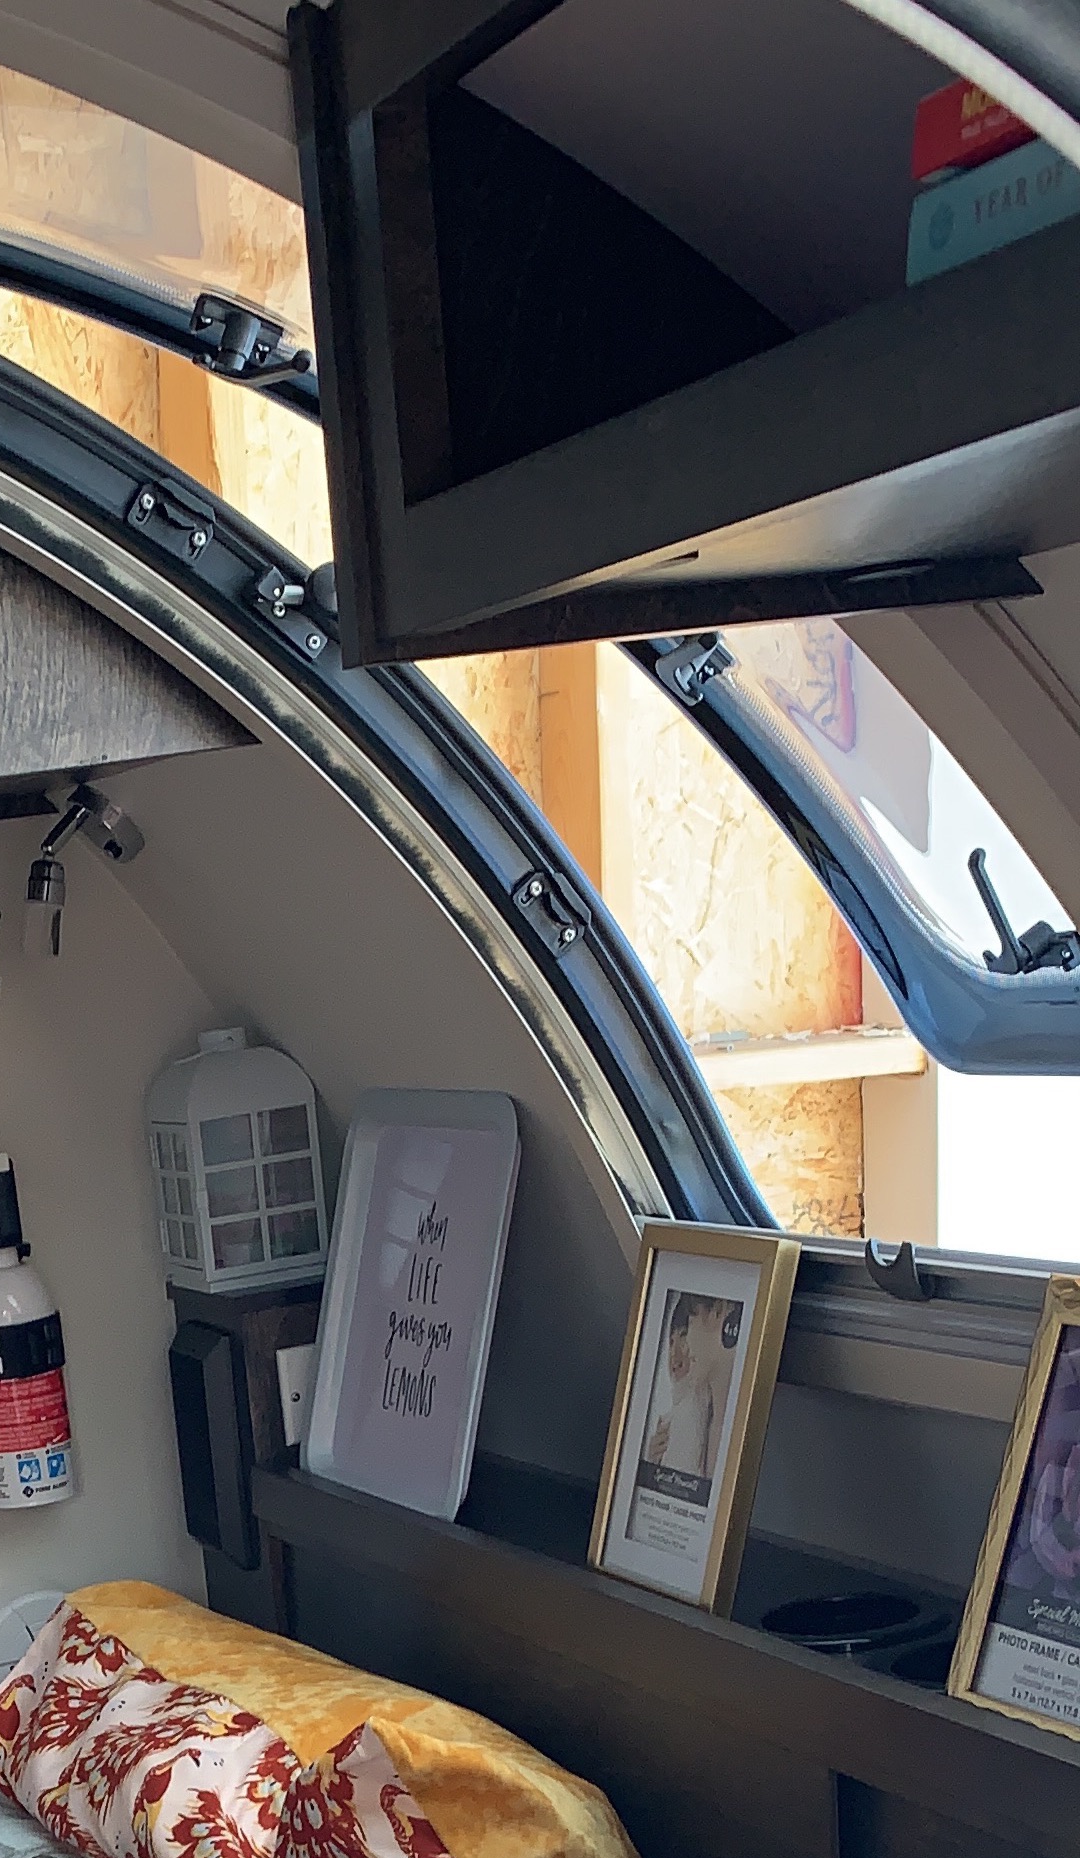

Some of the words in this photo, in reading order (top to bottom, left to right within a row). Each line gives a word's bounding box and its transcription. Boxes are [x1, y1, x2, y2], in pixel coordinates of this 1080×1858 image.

[417, 1200, 449, 1253] when
[407, 1252, 443, 1305] LIFE
[384, 1311, 426, 1360] gives
[423, 1321, 452, 1369] you
[382, 1359, 437, 1418] LEMONS
[998, 1631, 1029, 1652] PHOTO
[1029, 1641, 1061, 1662] FRAME
